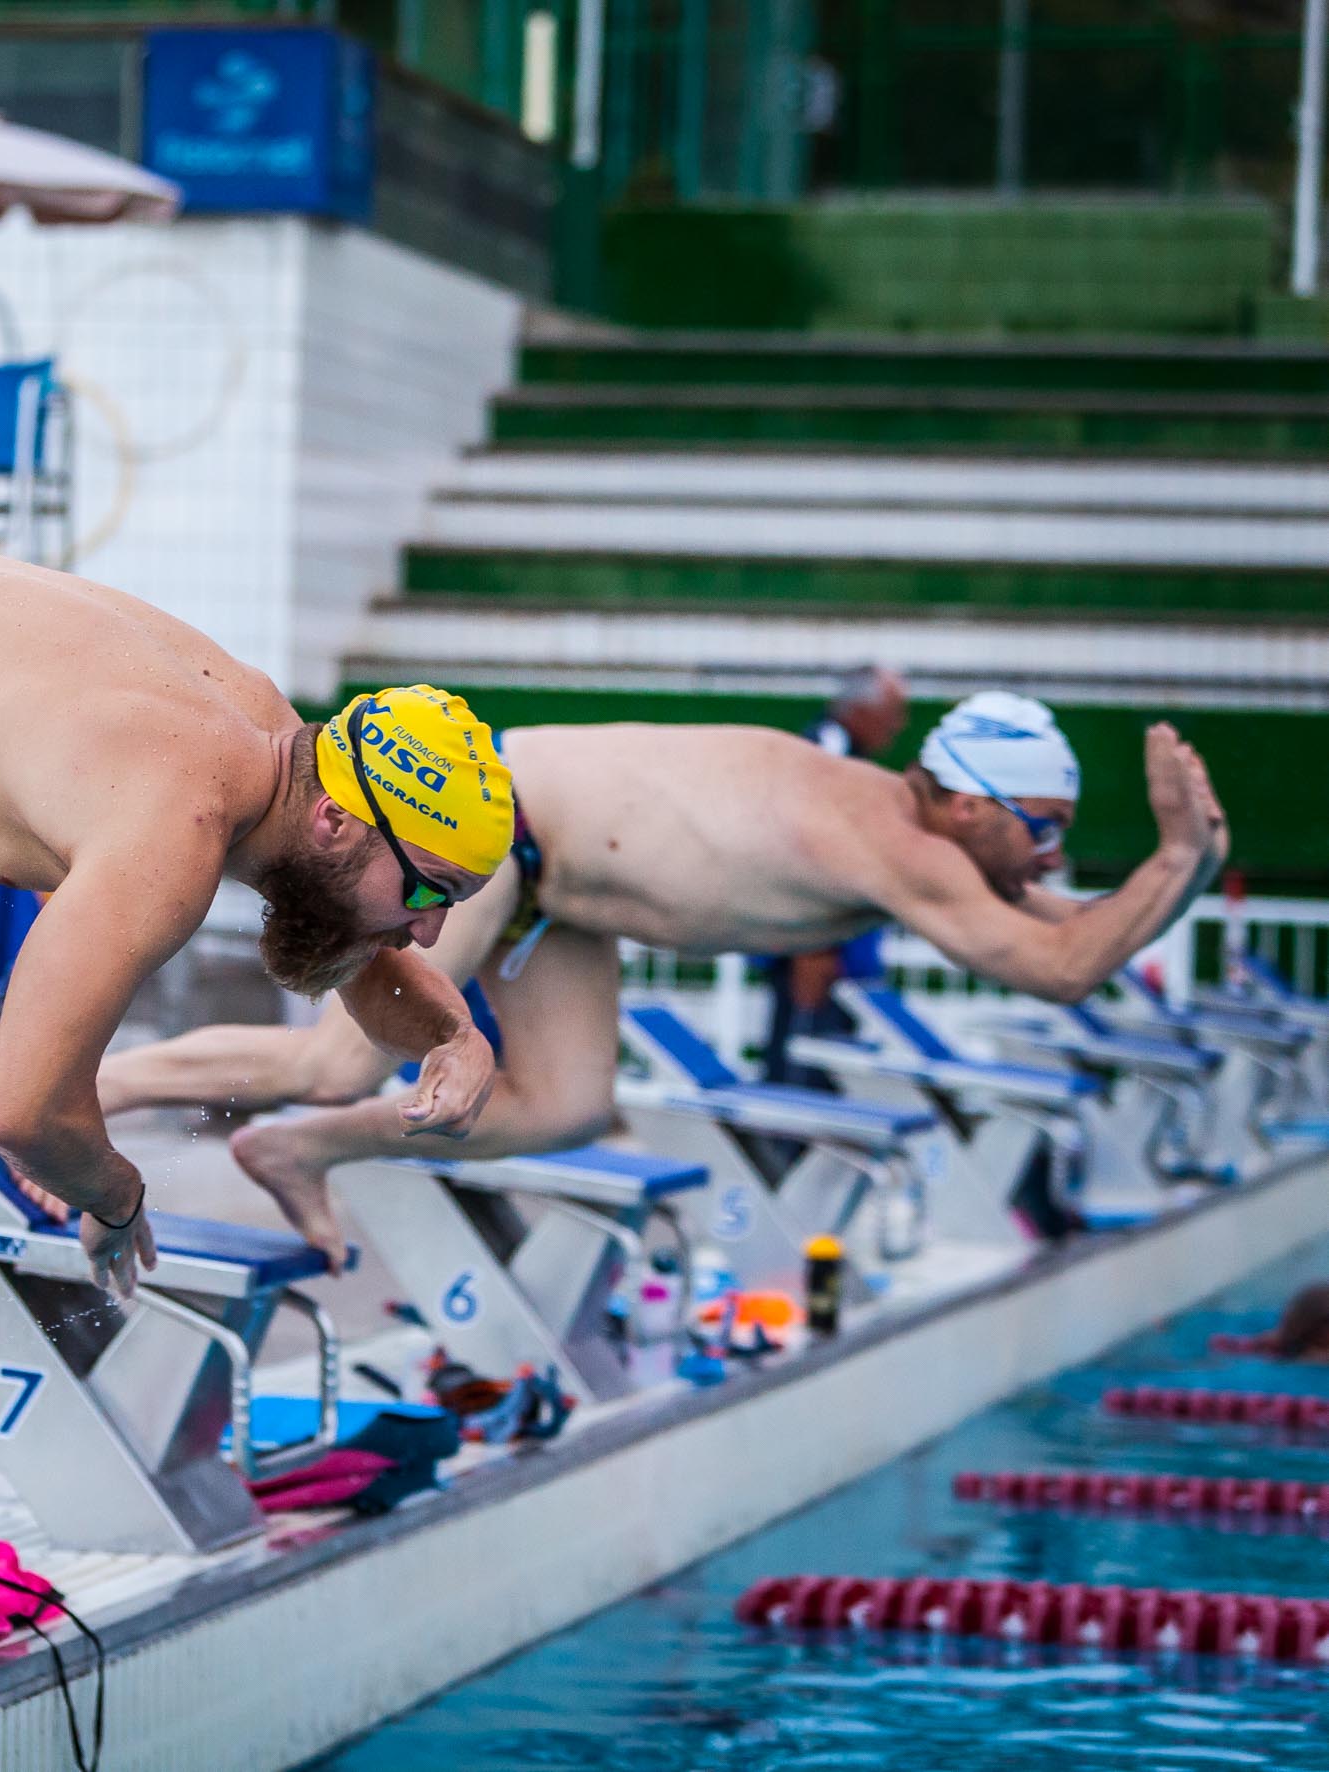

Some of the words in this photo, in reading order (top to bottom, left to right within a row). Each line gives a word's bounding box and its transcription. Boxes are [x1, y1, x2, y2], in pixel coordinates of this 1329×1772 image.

[392, 725, 456, 773] FUNDACIÓN
[361, 762, 458, 830] NAGRACAN
[713, 1186, 752, 1237] 5
[442, 1269, 479, 1324] 6
